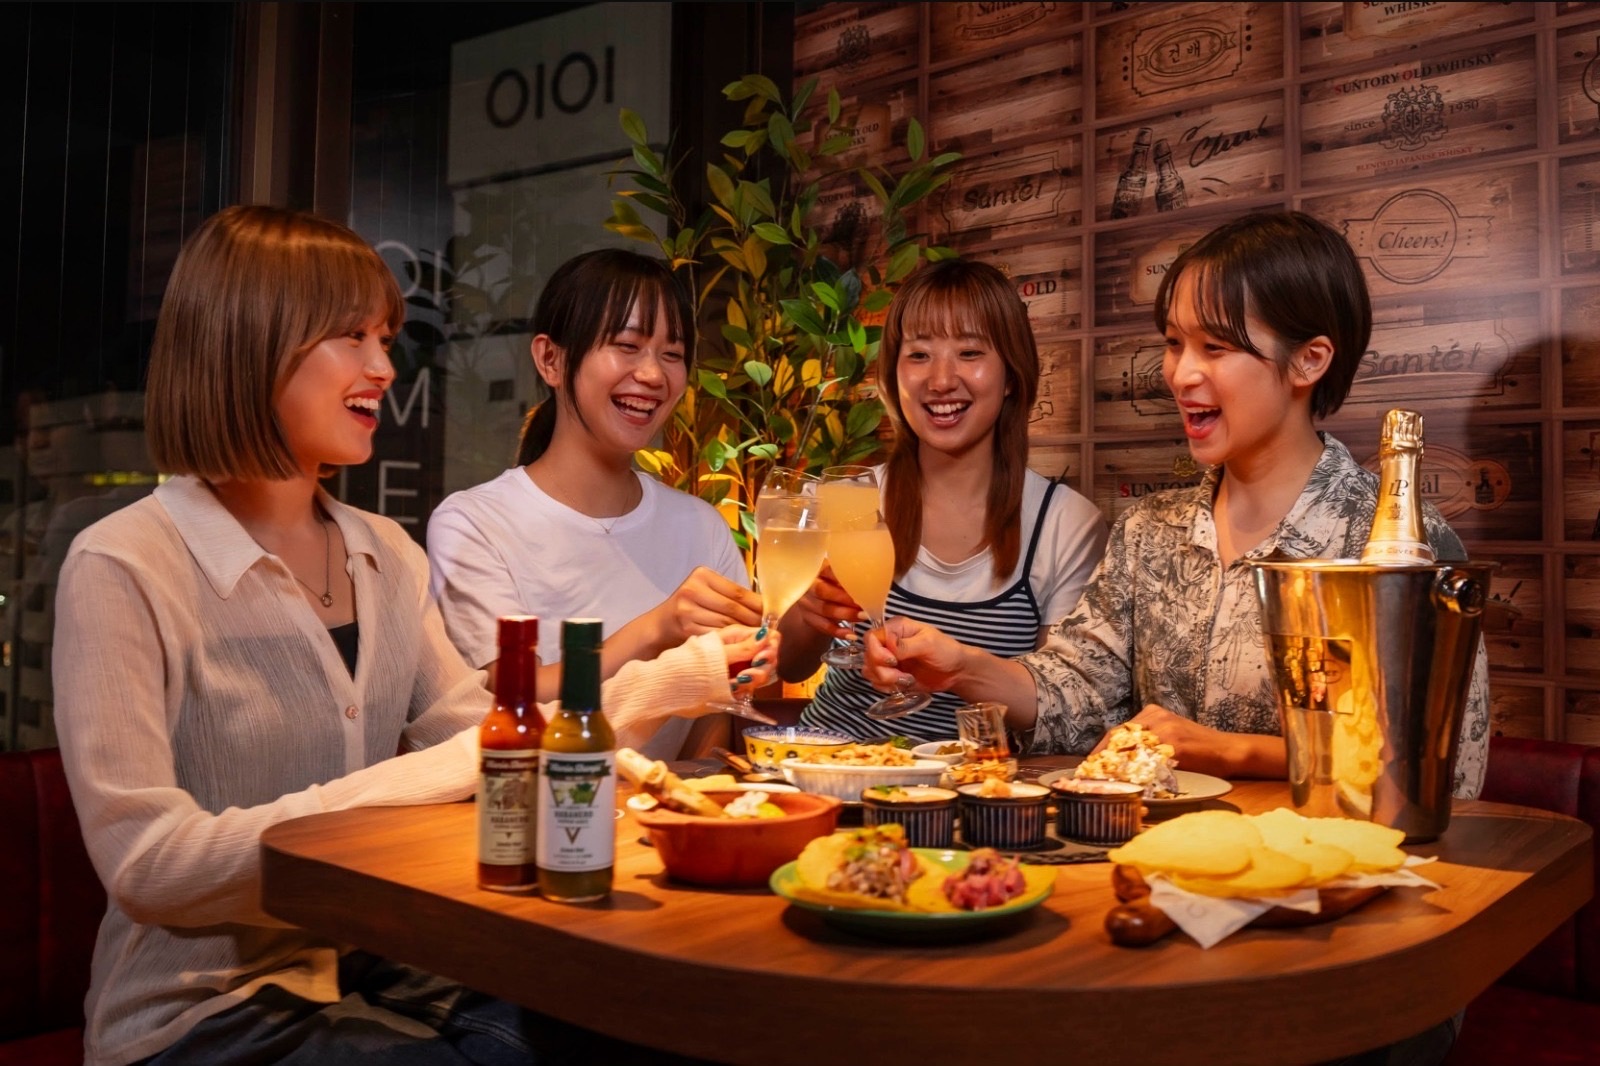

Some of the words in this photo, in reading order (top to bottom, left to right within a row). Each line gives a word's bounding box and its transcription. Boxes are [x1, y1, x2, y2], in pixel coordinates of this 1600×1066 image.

[1335, 72, 1399, 94] SUNTORY
[1402, 65, 1432, 81] OLD
[1436, 53, 1496, 73] WHISKY
[1344, 119, 1376, 132] since
[1448, 99, 1479, 115] 1950
[1438, 146, 1474, 158] WHISKY
[1378, 227, 1449, 249] Cheers!
[1023, 280, 1057, 297] OLD
[1357, 341, 1480, 376] Santé!
